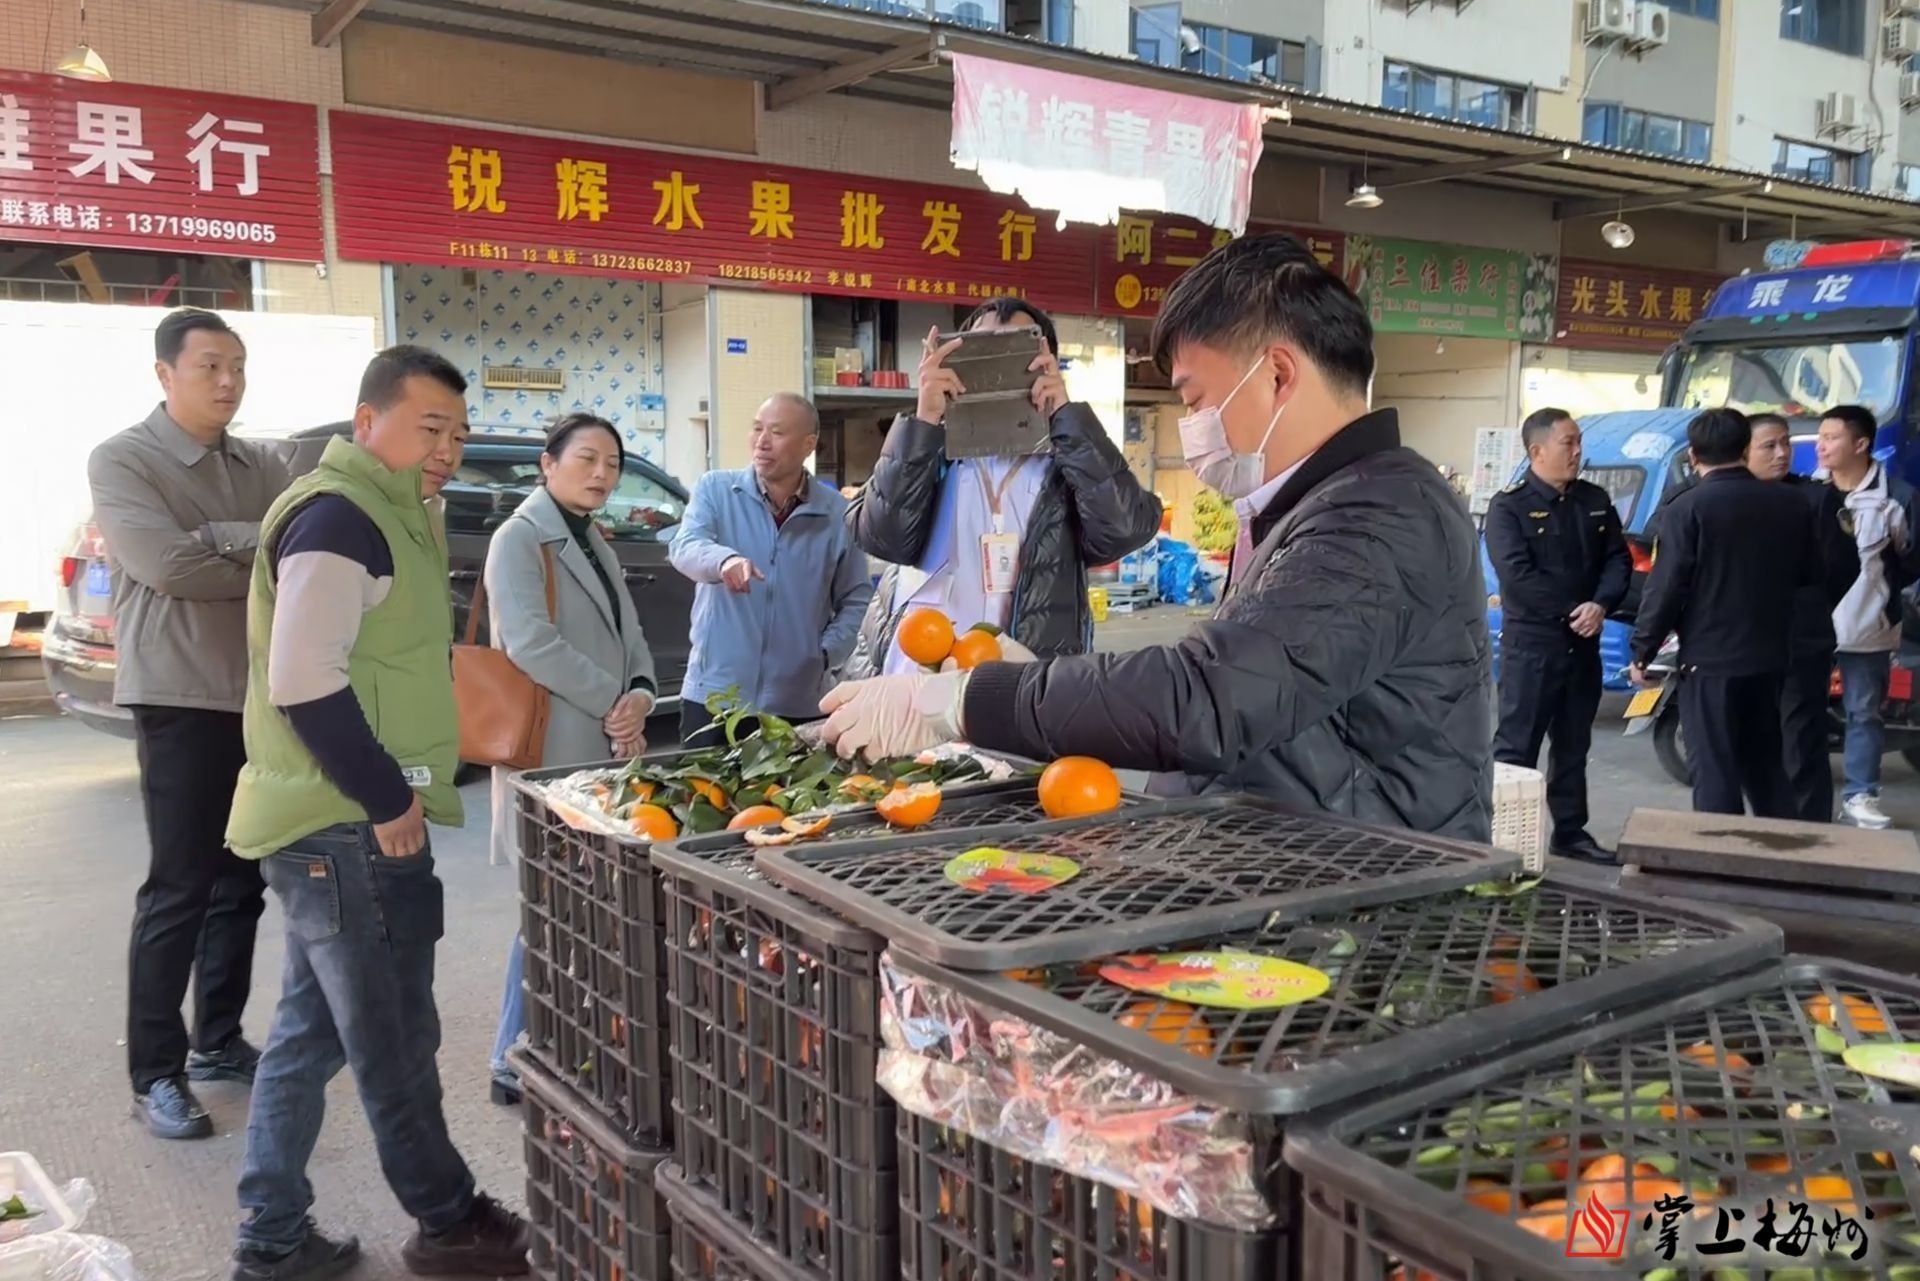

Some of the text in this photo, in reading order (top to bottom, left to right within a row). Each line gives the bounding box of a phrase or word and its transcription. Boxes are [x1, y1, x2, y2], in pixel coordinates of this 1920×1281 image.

[447, 145, 1037, 261] 锐辉水果批发行
[1570, 276, 1713, 322] 光头水果
